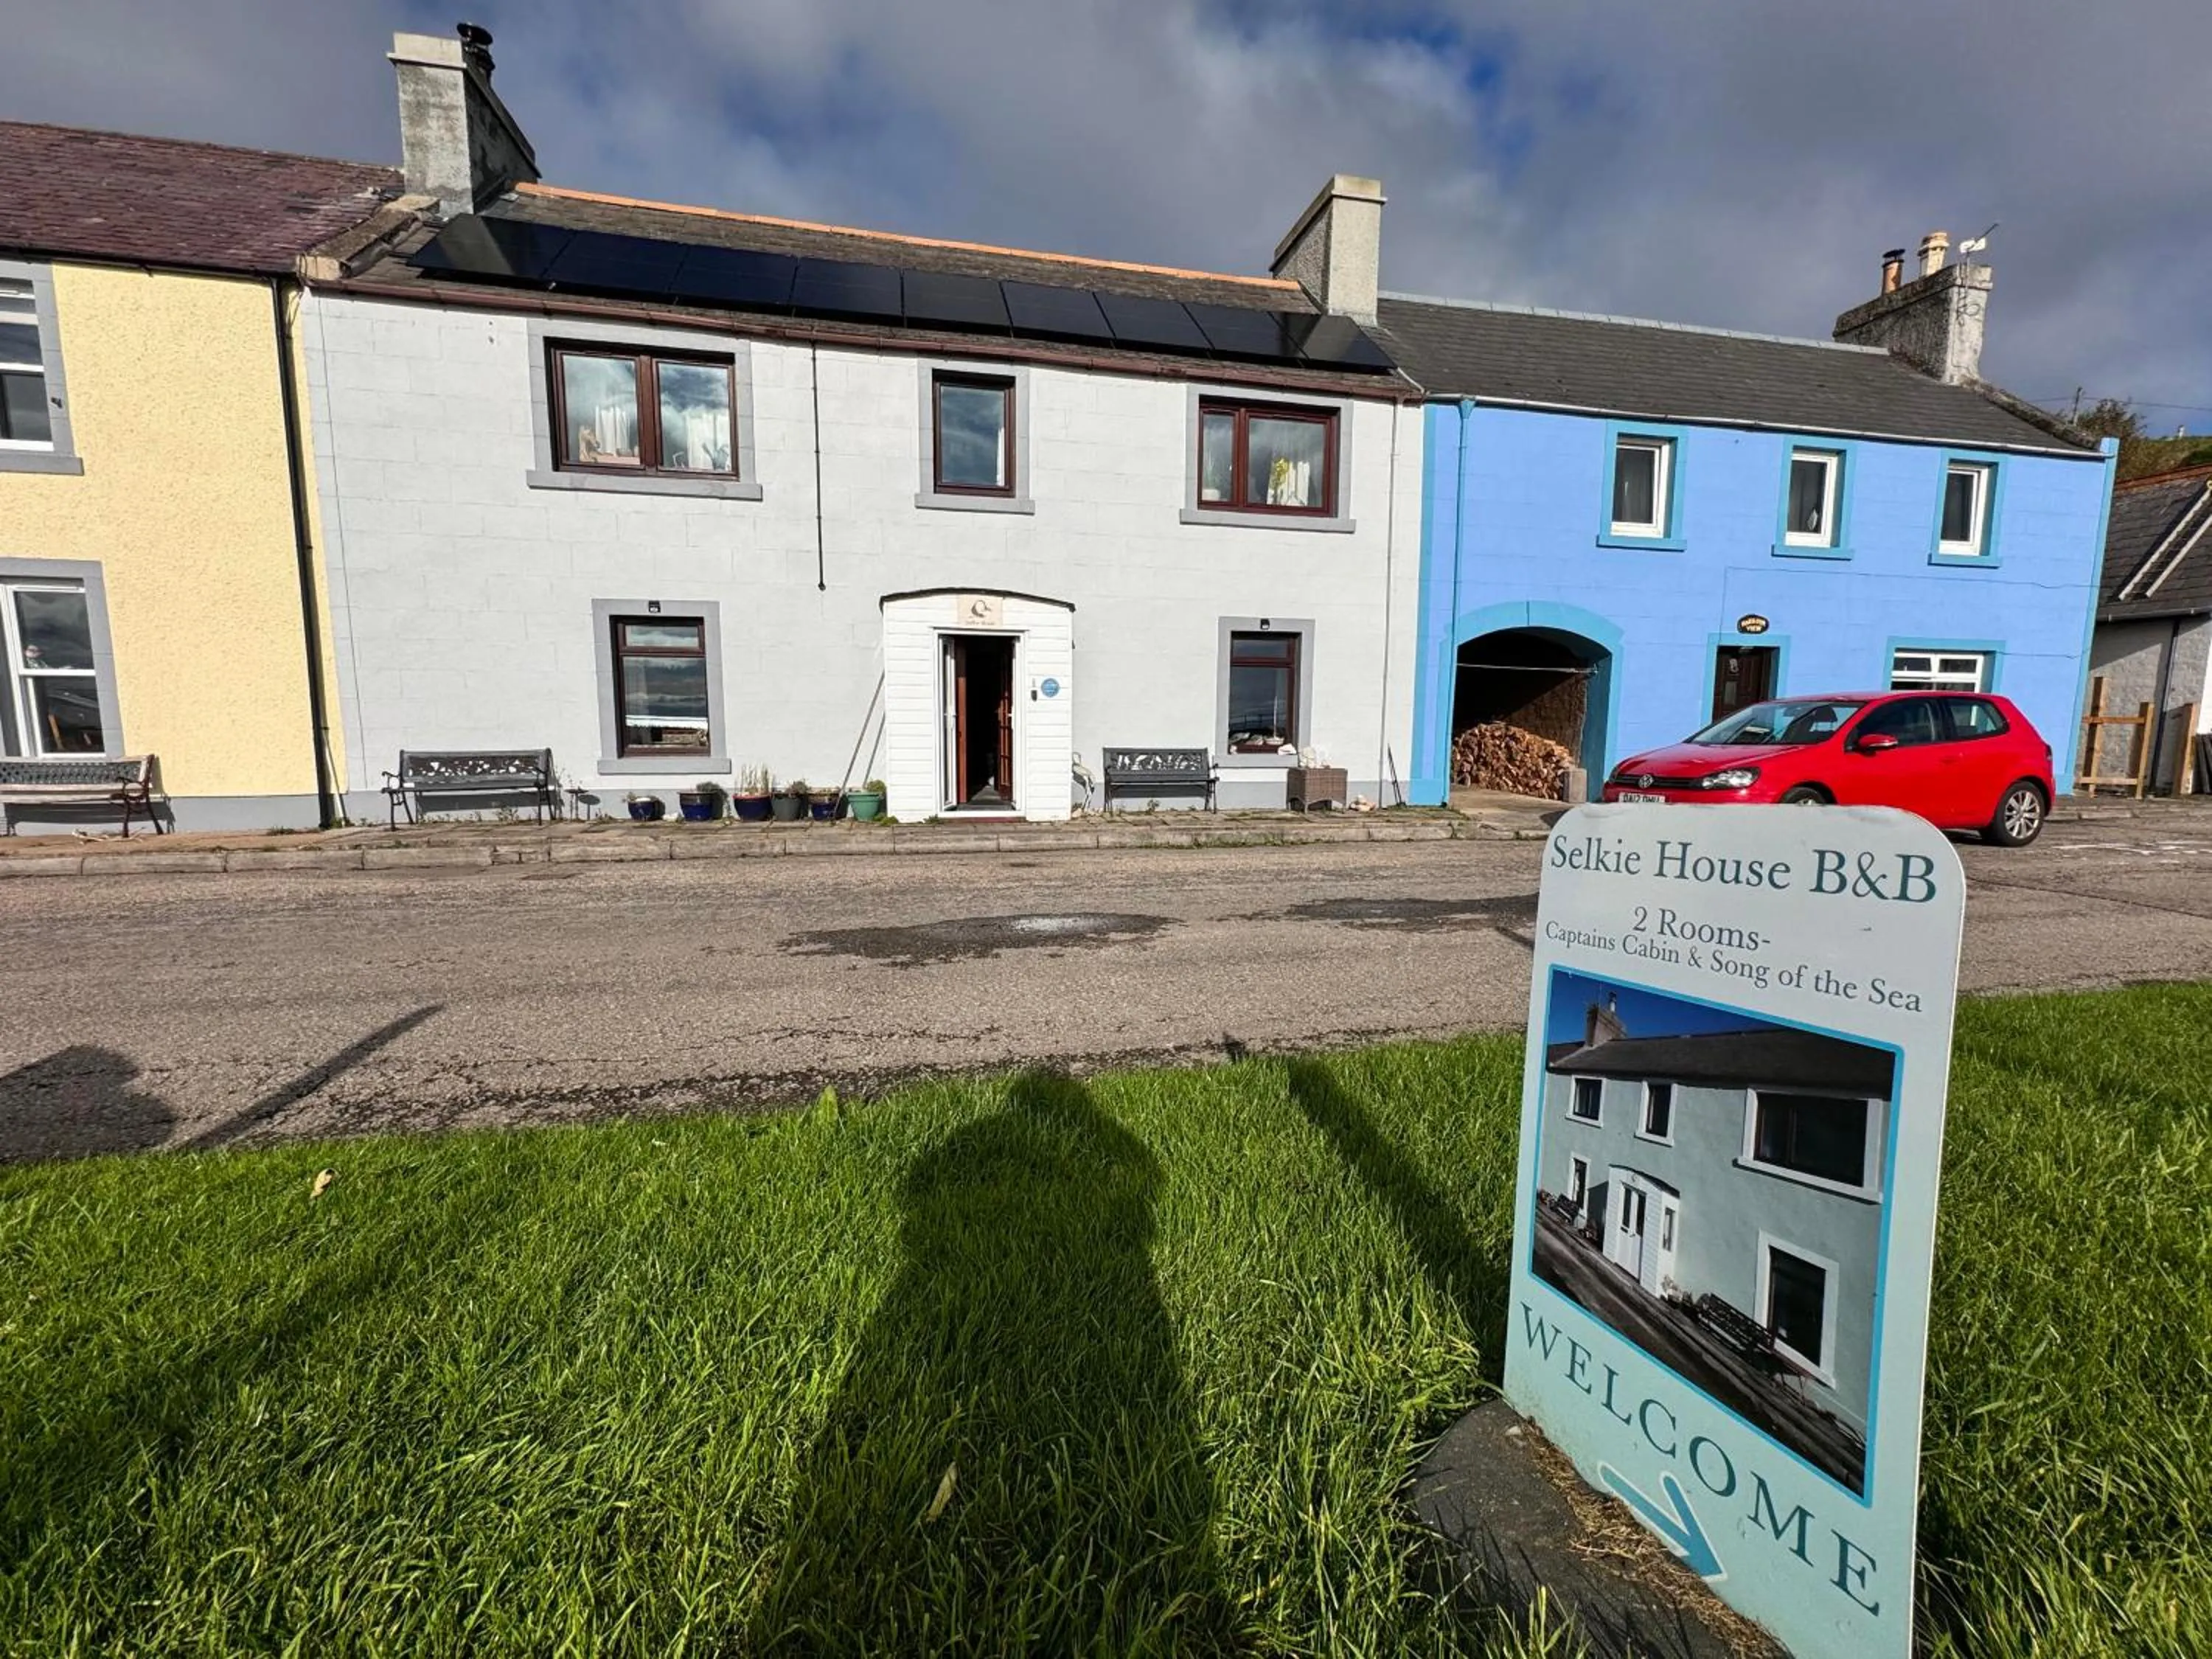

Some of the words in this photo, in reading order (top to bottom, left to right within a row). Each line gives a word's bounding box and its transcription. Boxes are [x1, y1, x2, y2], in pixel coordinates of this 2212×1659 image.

[1551, 834, 1641, 875] Selkie
[1653, 840, 1791, 890] House
[1809, 849, 1937, 903] B&B
[1545, 920, 1615, 951] Captains
[1622, 934, 1680, 964] Cabin
[1688, 945, 1703, 970] &
[1710, 949, 1770, 989] Song
[1778, 964, 1808, 989] of
[1814, 970, 1858, 999] the
[1868, 978, 1923, 1012] Sea
[1632, 906, 1649, 932] 2
[1657, 908, 1770, 951] Rooms-
[1520, 1301, 1881, 1617] WELCOME
